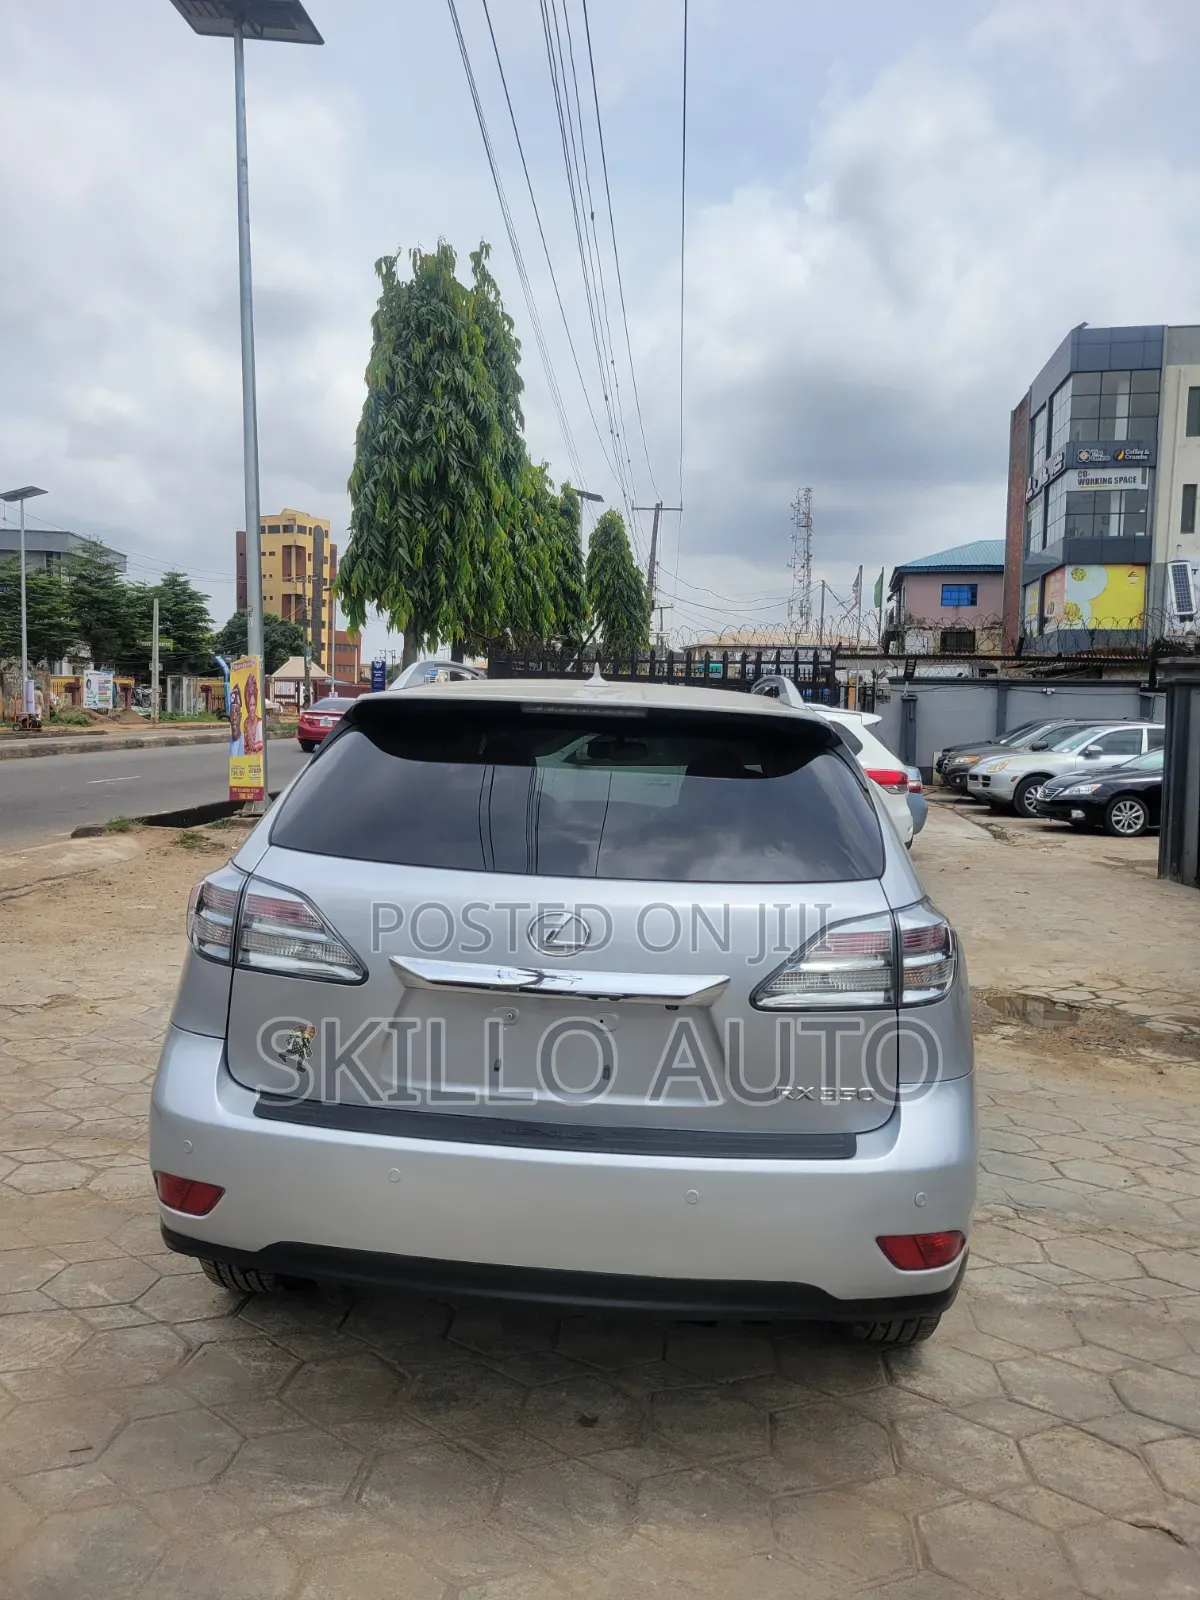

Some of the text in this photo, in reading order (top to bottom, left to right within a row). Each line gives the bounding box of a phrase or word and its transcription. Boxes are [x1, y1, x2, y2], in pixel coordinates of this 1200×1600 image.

[1078, 470, 1090, 478] CO-
[1078, 476, 1137, 486] WORKING SPACE
[776, 1086, 815, 1101] RX
